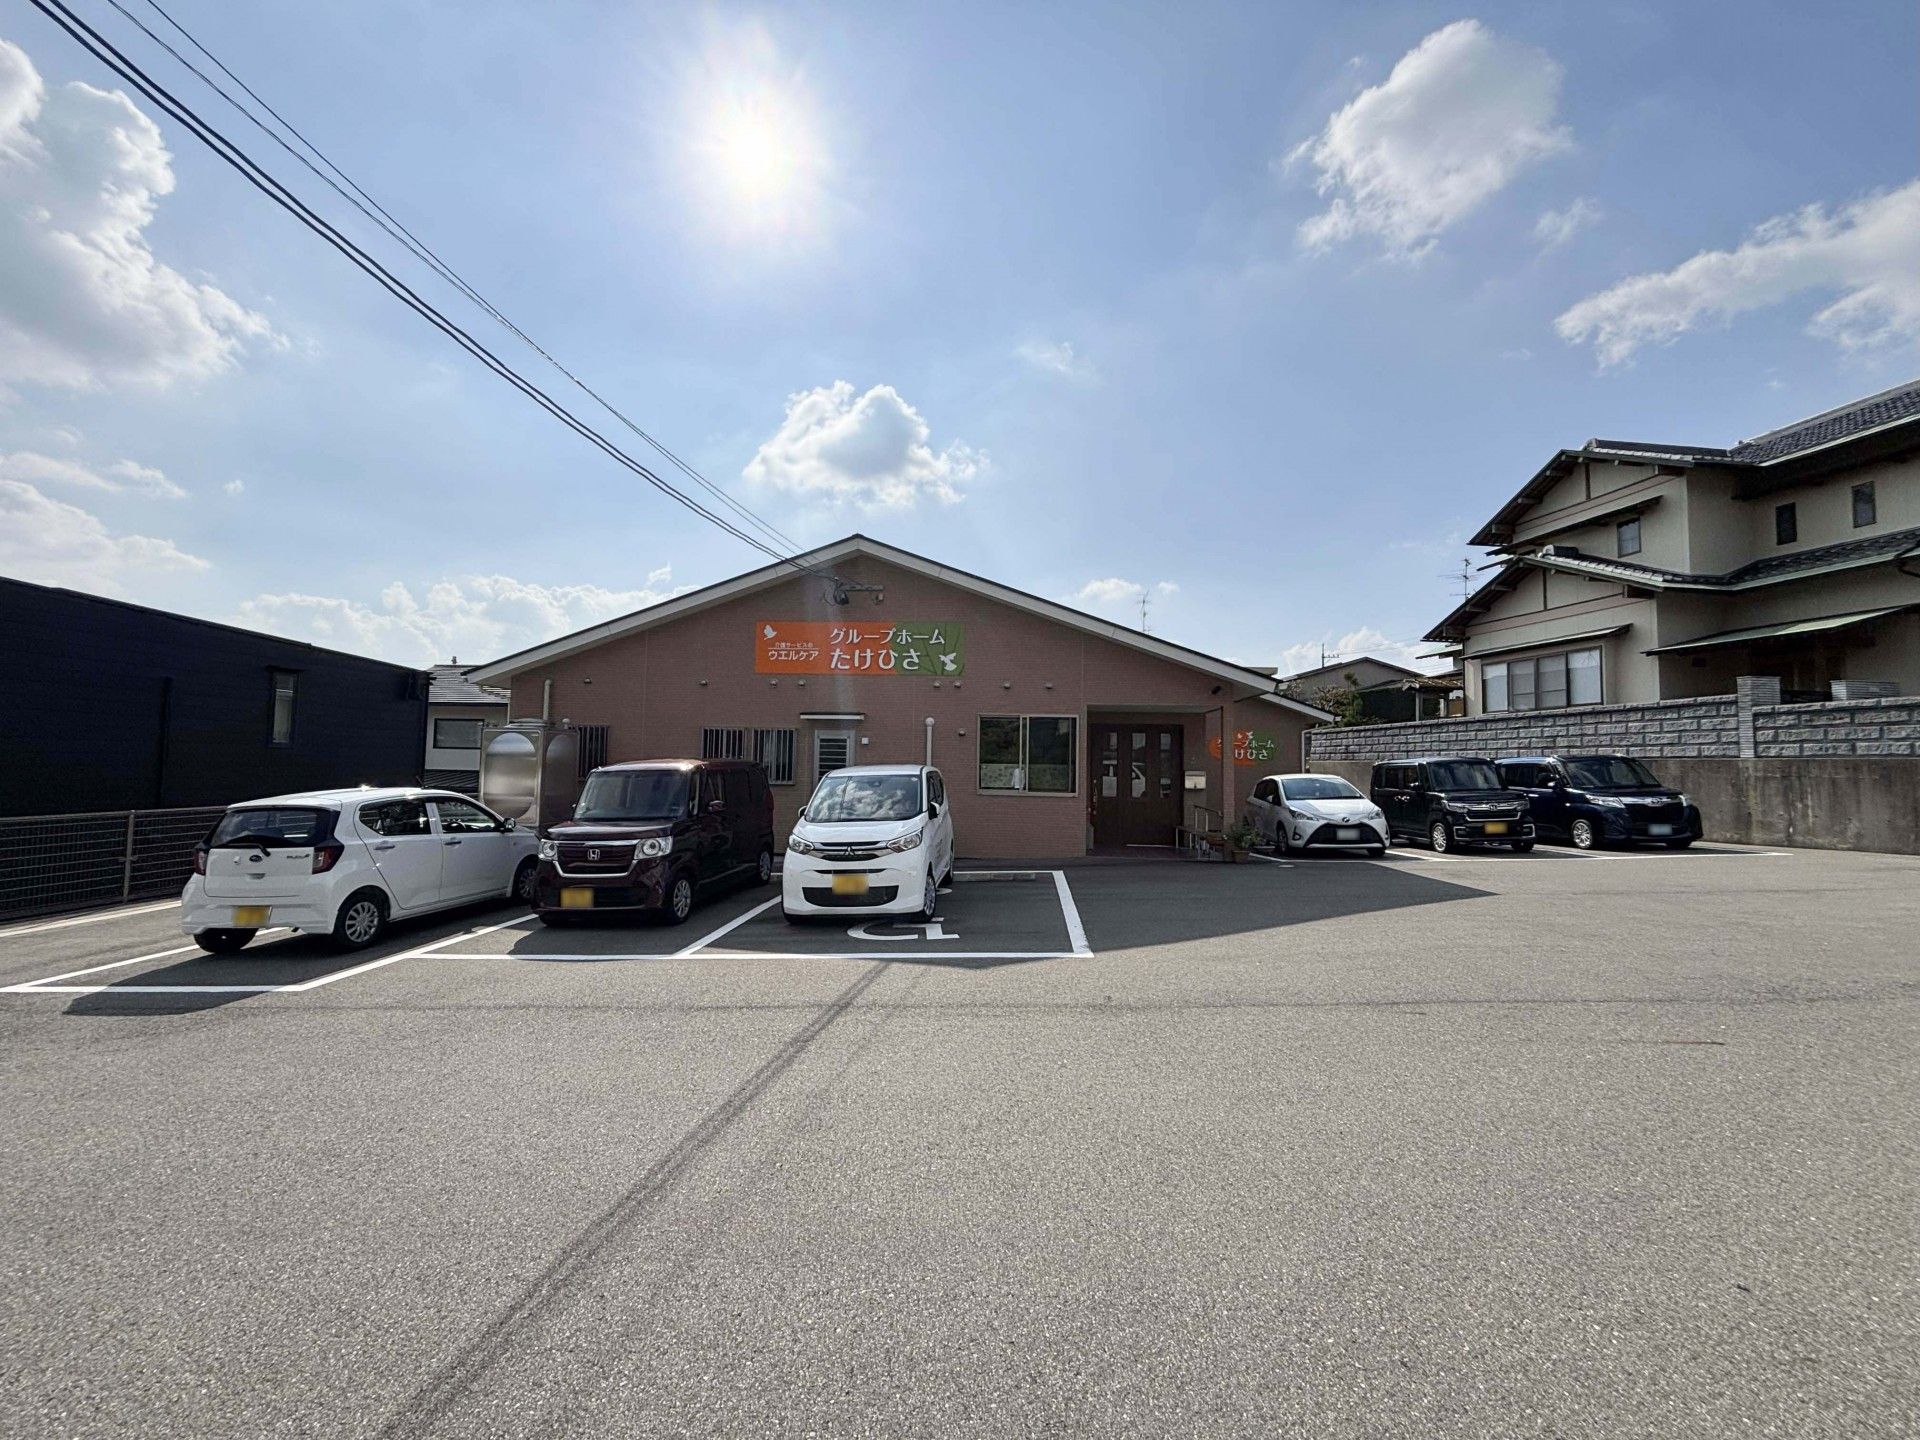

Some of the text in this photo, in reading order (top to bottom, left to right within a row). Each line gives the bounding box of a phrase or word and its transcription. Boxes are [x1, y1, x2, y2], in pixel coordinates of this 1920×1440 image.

[830, 627, 945, 645] グループホーム
[768, 650, 819, 661] ウエルケア
[830, 648, 921, 670] たけひさ
